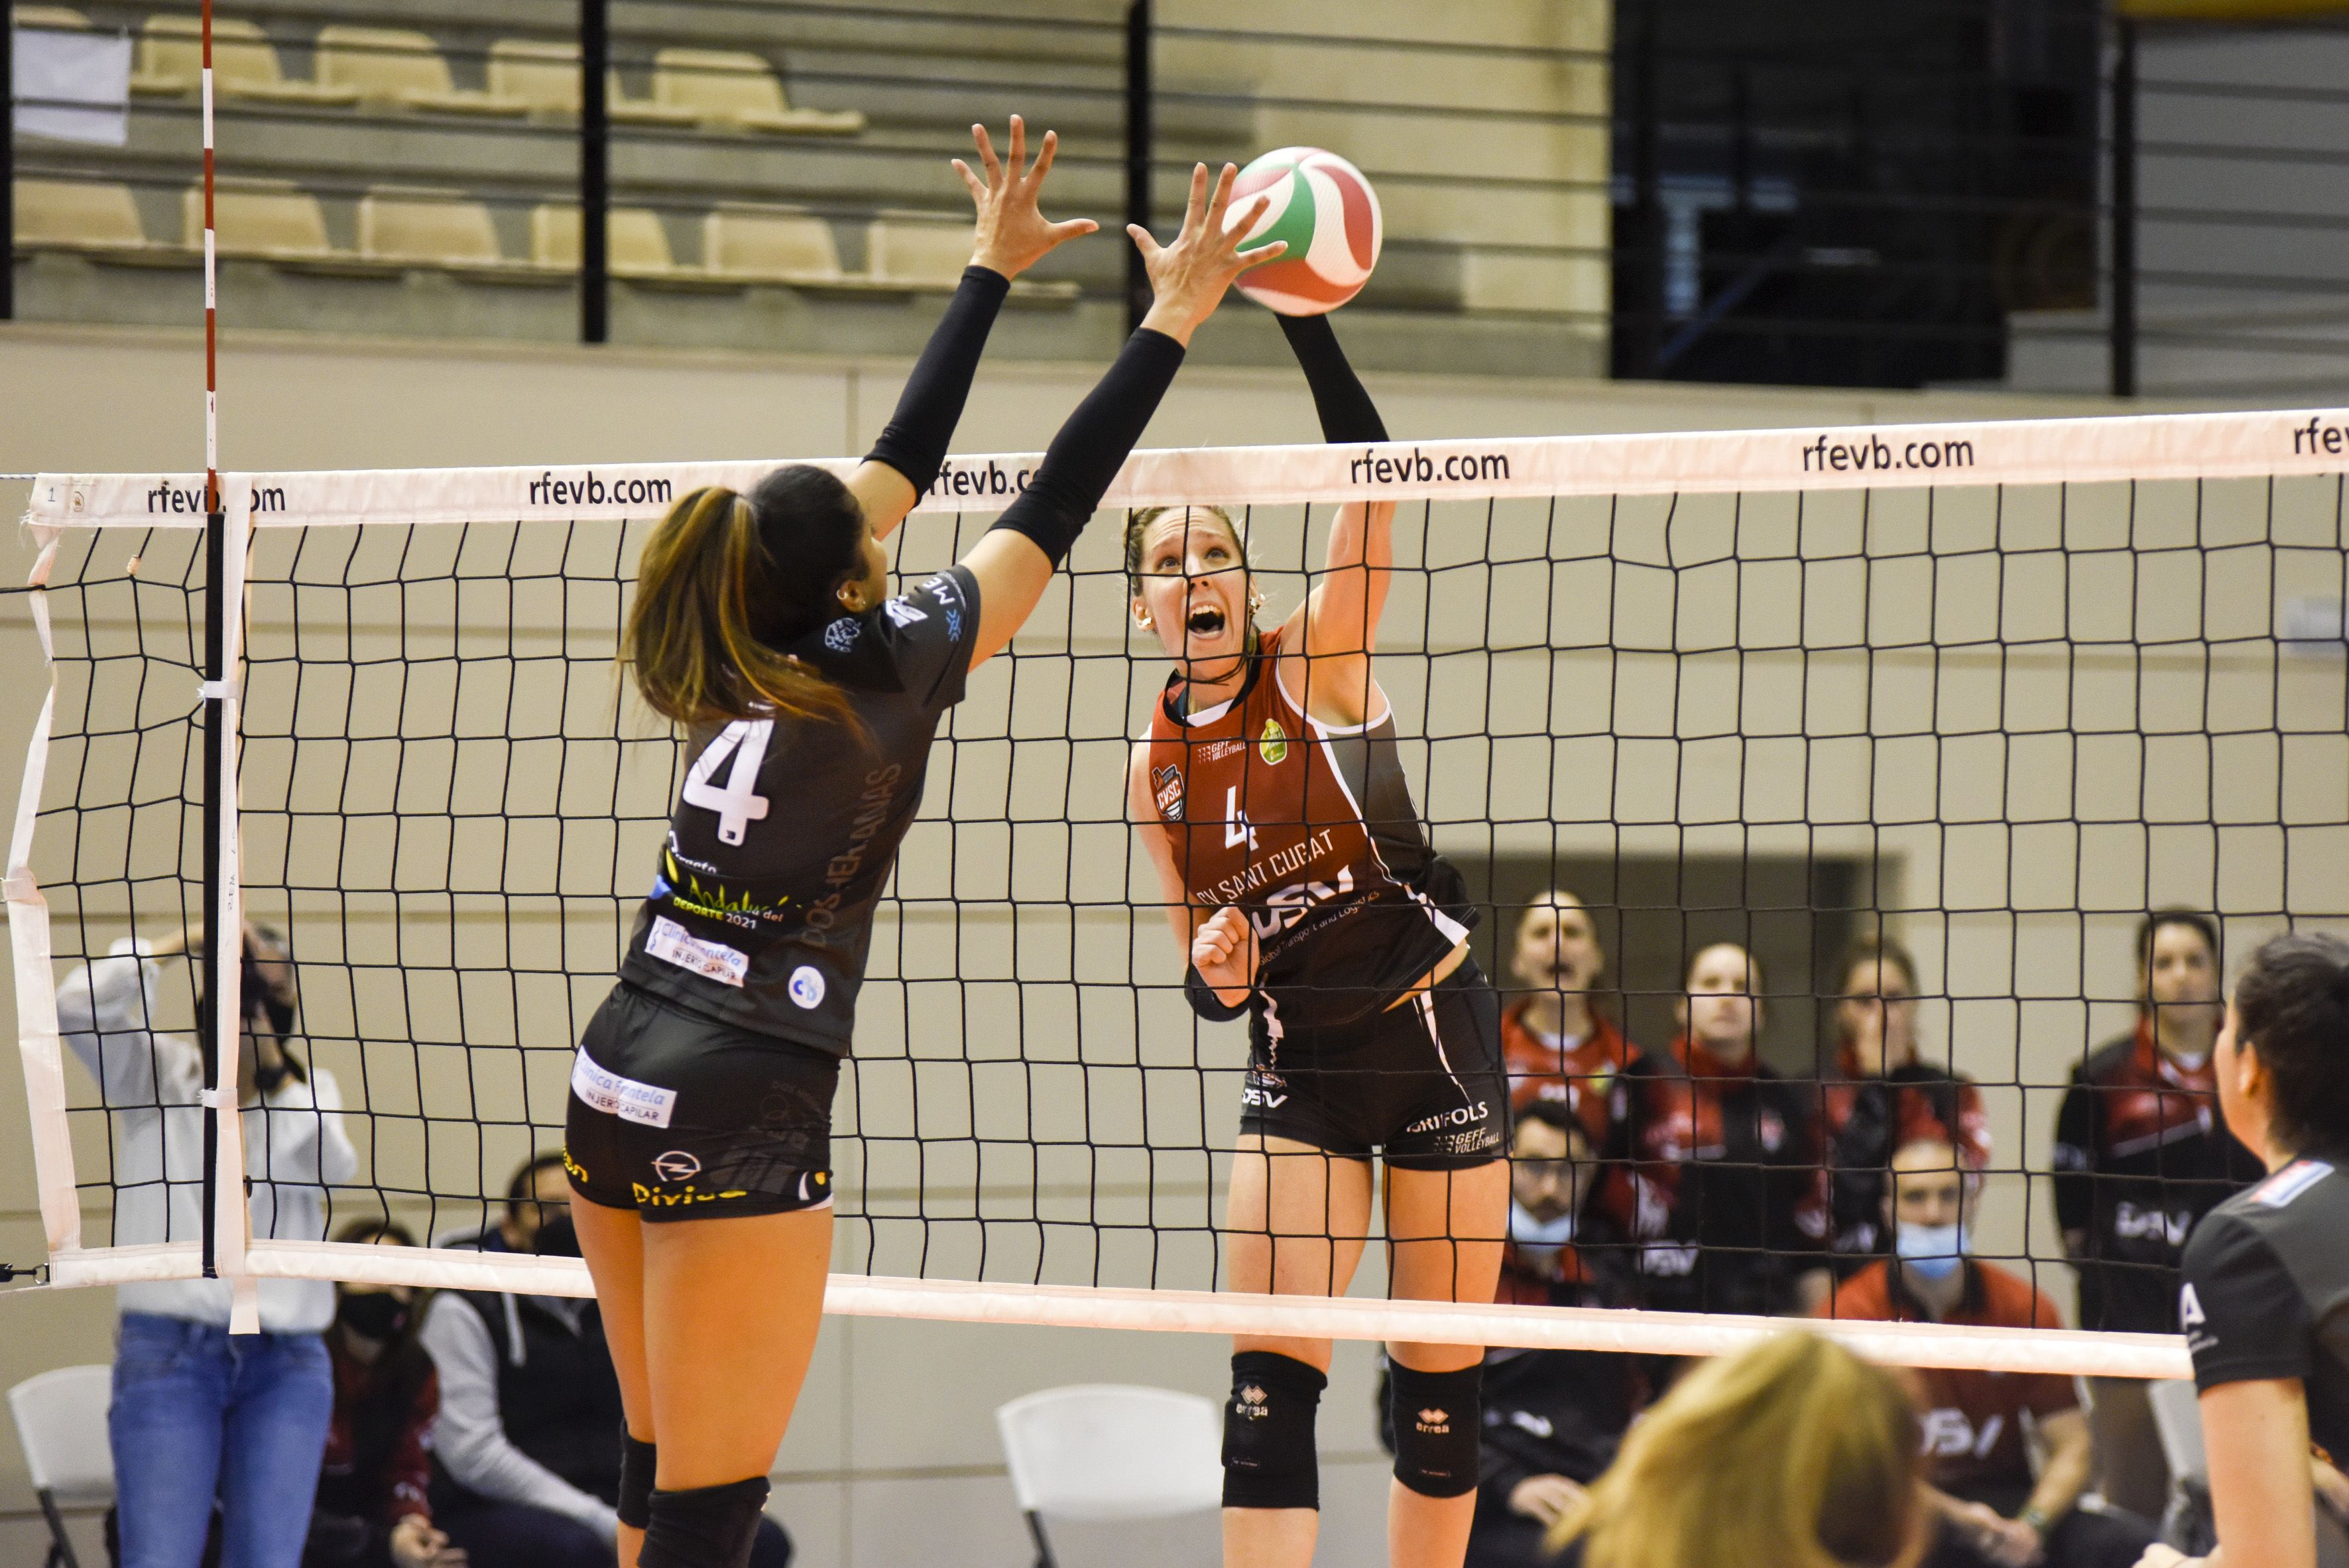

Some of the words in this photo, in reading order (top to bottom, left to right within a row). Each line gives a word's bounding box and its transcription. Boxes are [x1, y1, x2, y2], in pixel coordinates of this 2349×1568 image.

[1803, 433, 1975, 471] rfevb.com
[2294, 416, 2349, 454] rfe
[1351, 447, 1510, 483] rfevb.com
[530, 470, 672, 505] rfevb.com
[1212, 741, 1246, 761] VOLLEYBALL
[683, 701, 776, 847] 4
[1157, 780, 1181, 810] CVSC
[1225, 785, 1259, 851] 4
[1218, 862, 1268, 900] SANT
[1269, 829, 1334, 877] CUGAT
[673, 896, 724, 920] DEPORTE
[726, 913, 758, 930] 2021
[763, 910, 784, 922] del
[1242, 1087, 1288, 1109] DSV
[1406, 1101, 1488, 1133] GRIFOLS
[1455, 1131, 1500, 1154] VOLLEYBALL
[1456, 1127, 1486, 1145] GEFF
